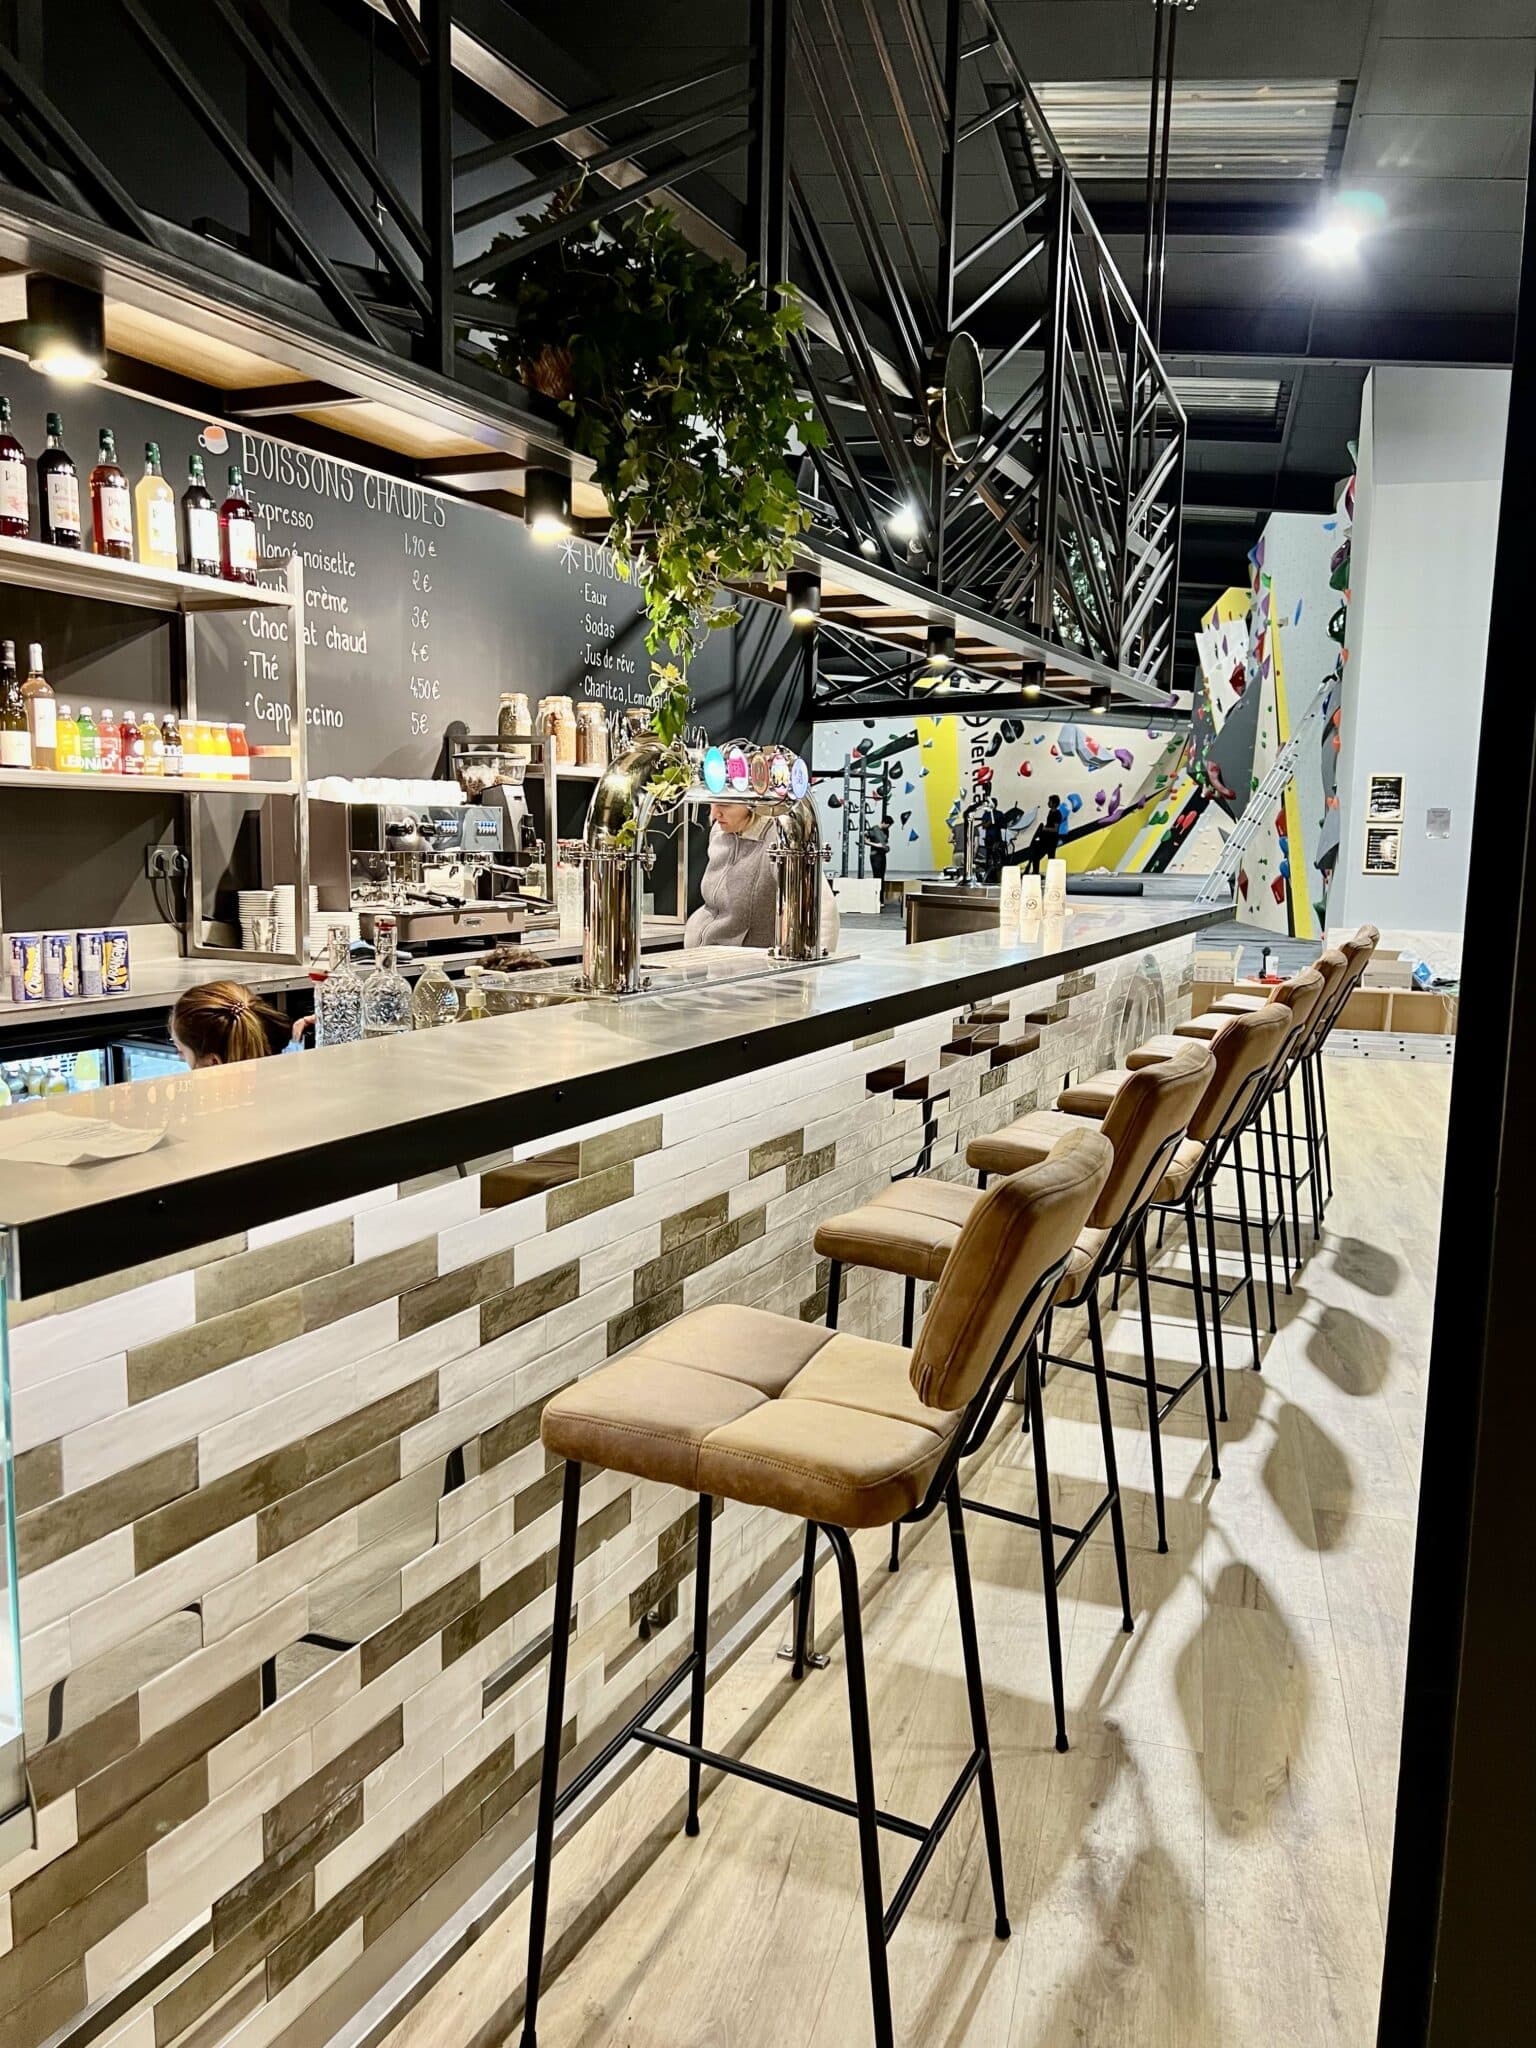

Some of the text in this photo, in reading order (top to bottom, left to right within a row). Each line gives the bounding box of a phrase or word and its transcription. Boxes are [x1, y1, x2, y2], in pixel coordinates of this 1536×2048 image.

[241, 433, 447, 528] BOISSONS CHAUDES
[245, 488, 314, 532] Expresso
[303, 549, 357, 577] noisette
[305, 585, 349, 614] crème
[584, 582, 608, 607] Eaux
[411, 605, 430, 629] 3€
[585, 613, 616, 639] Sodas
[249, 610, 368, 654] Chocat chaud
[249, 651, 279, 680] Thé
[411, 641, 429, 663] 4€
[584, 643, 602, 667] Jus
[603, 648, 613, 669] de
[254, 692, 344, 736] Cappccino
[411, 711, 429, 735] 5€
